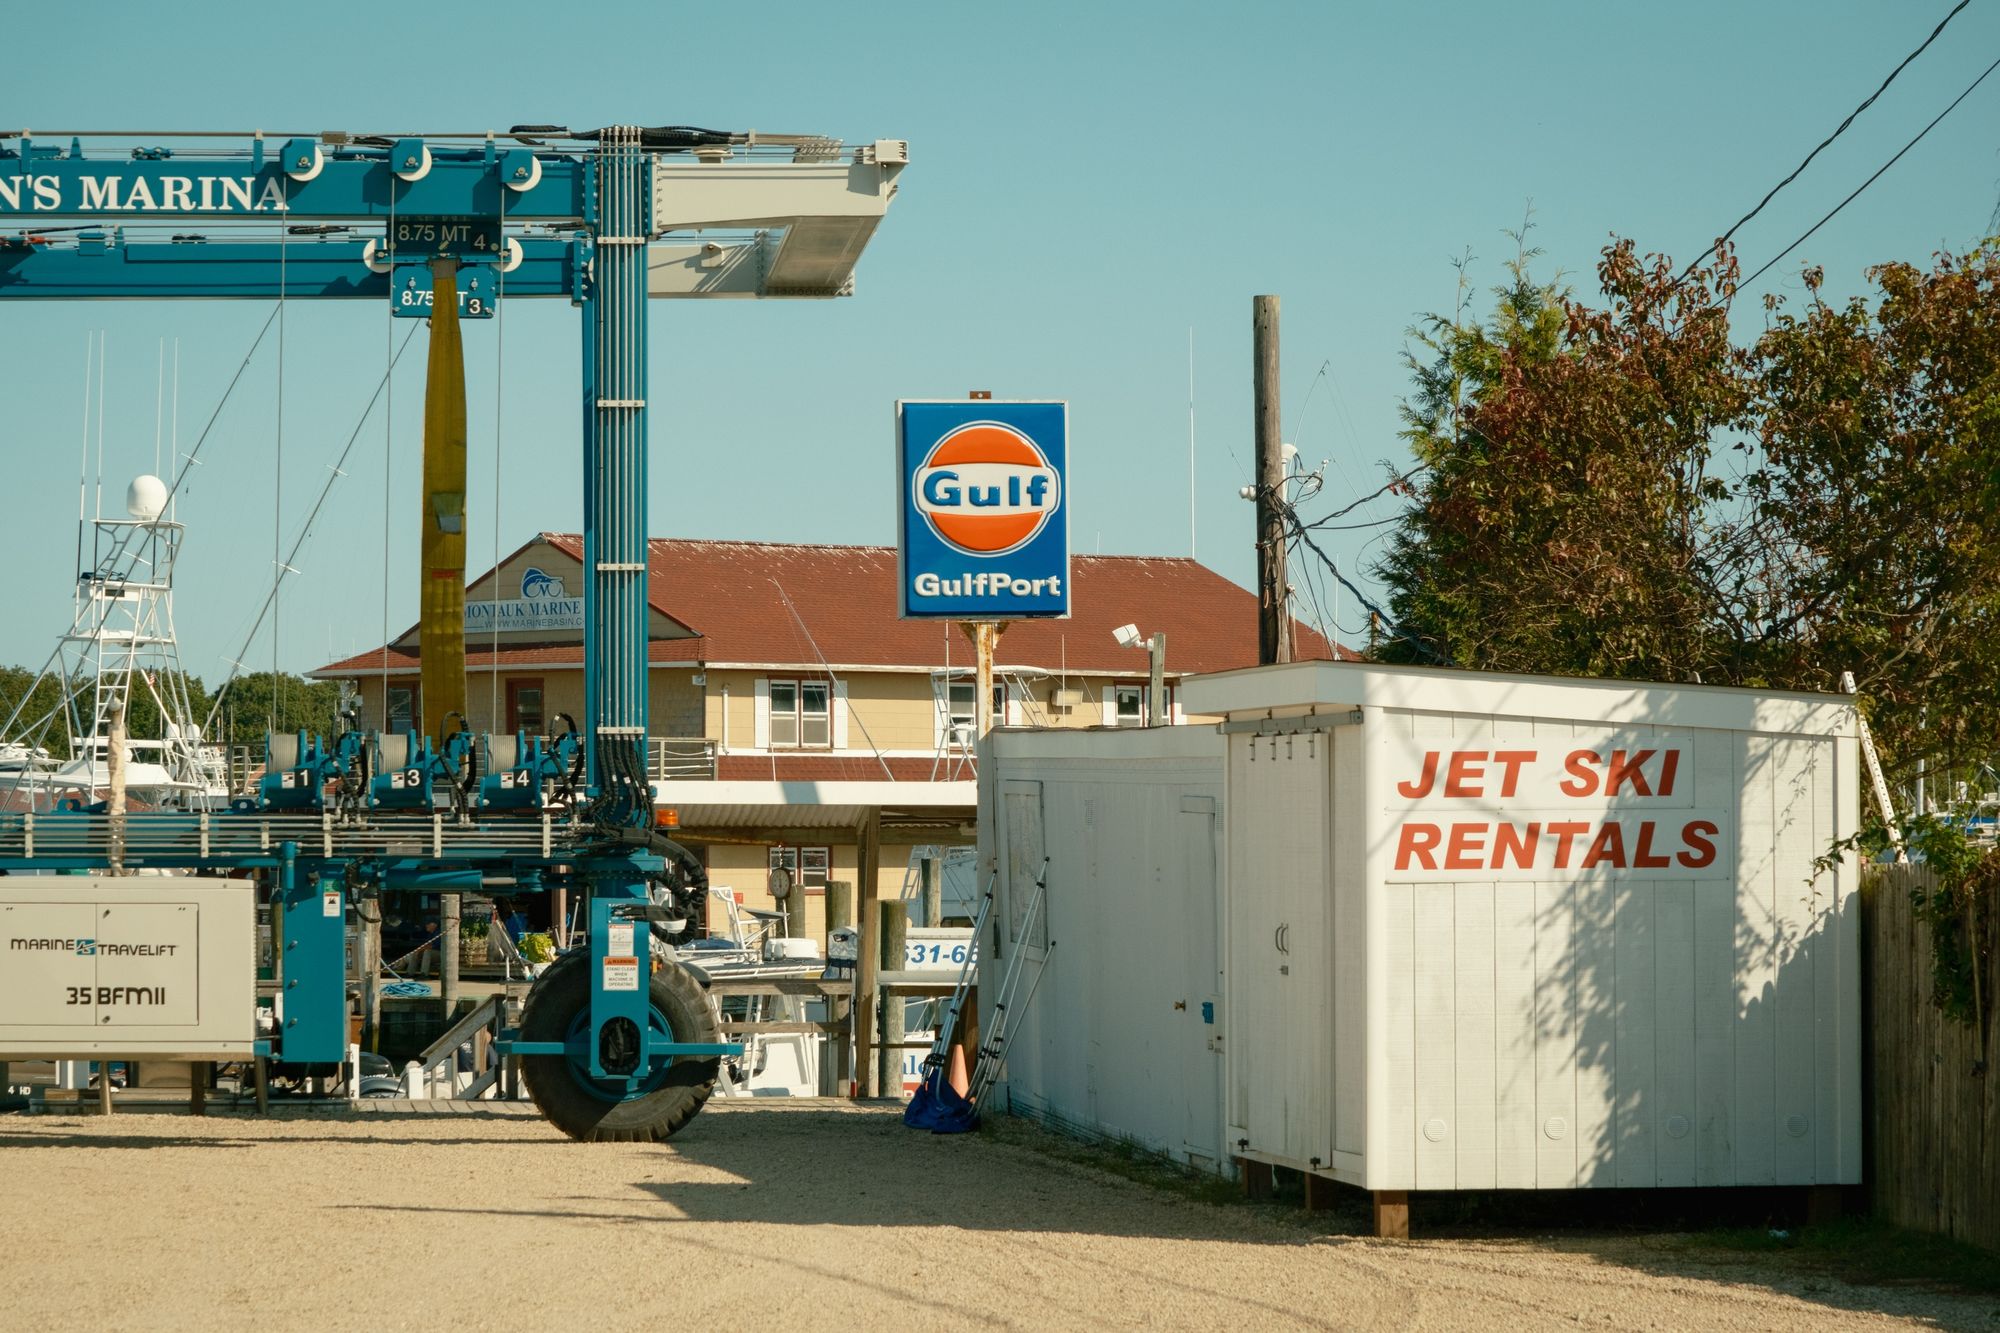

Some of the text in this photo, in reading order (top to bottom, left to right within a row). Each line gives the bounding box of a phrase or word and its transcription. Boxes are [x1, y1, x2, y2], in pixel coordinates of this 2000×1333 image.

[78, 174, 290, 211] MARINA
[398, 224, 471, 242] 8.75 MT
[473, 233, 486, 250] 4
[401, 290, 434, 306] 8.75
[469, 298, 481, 314] 3
[923, 470, 1049, 507] Gulf
[914, 572, 1061, 597] GulfPort
[529, 601, 580, 615] MARINE
[300, 769, 309, 786] 1
[407, 769, 421, 787] 3
[516, 769, 530, 787] 4
[1397, 749, 1680, 799] JET SKI
[1394, 820, 1720, 870] RENTALS
[10, 938, 177, 956] MARINE TRAVELIFT
[66, 987, 165, 1005] 35 BFMII
